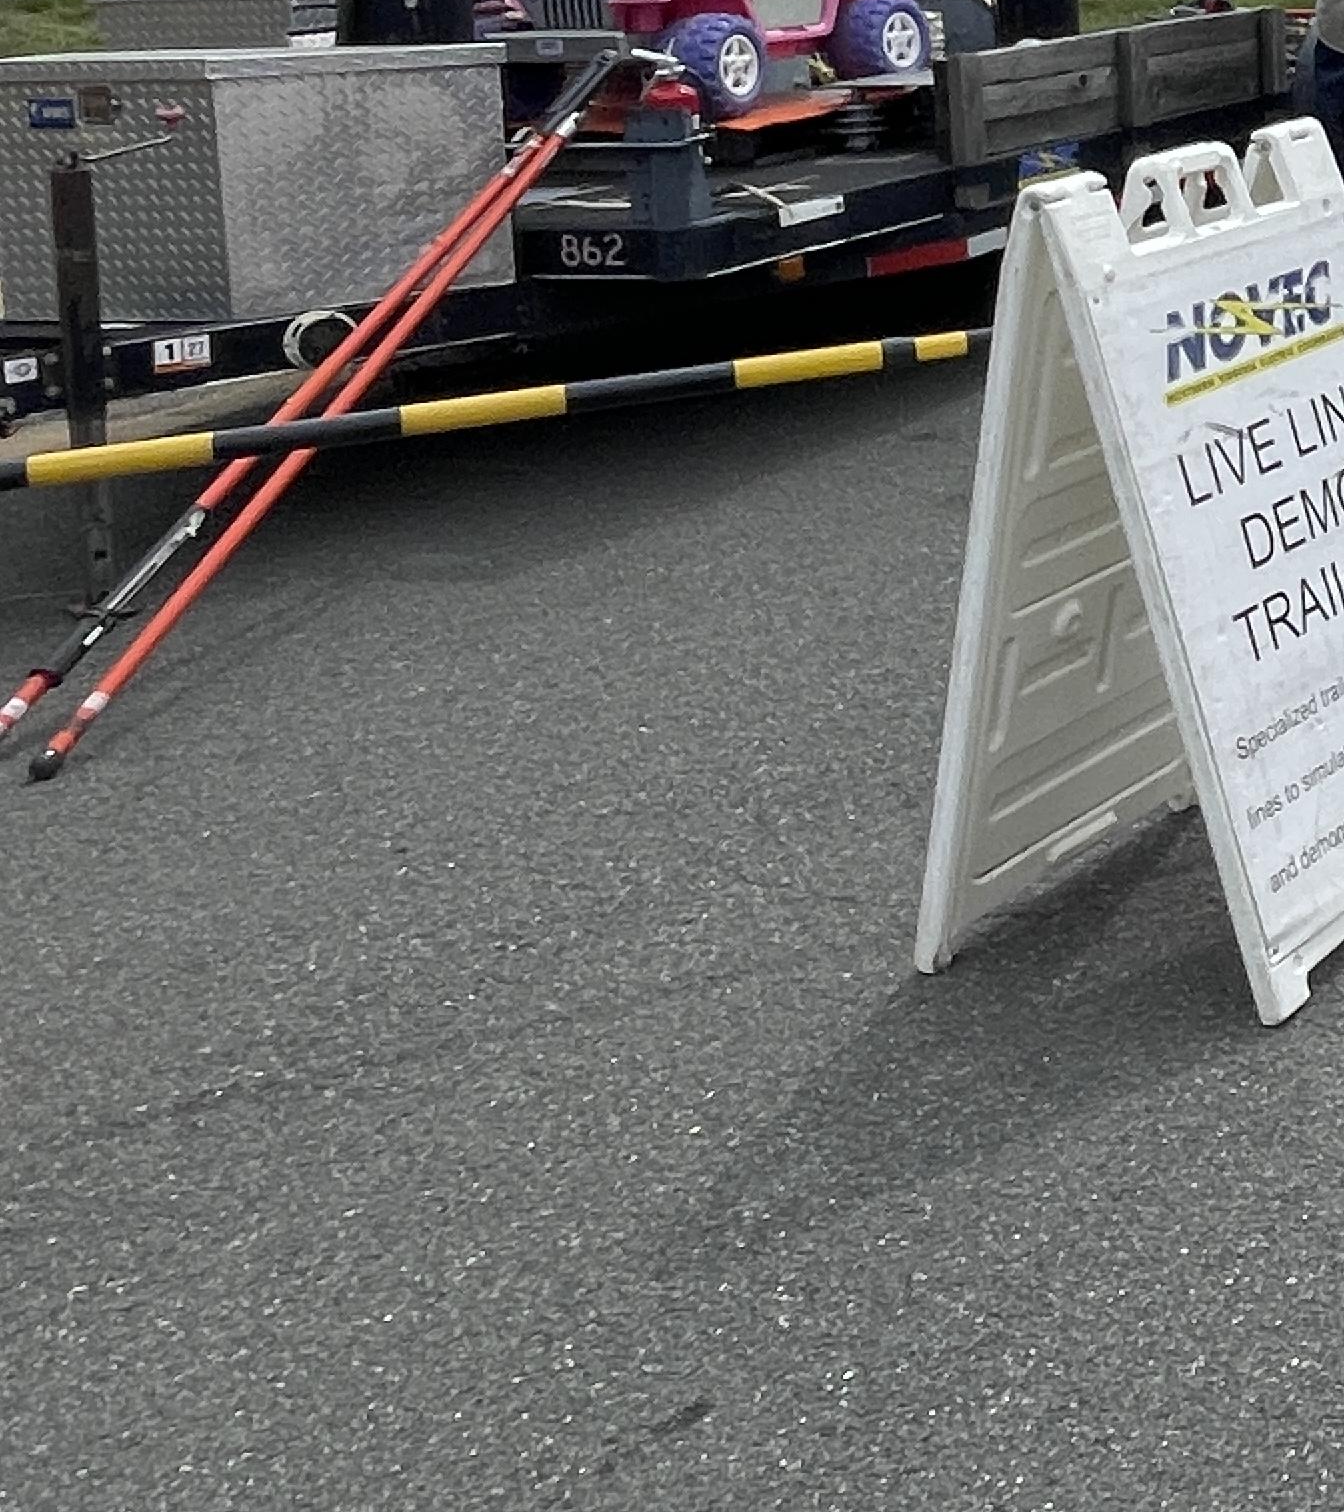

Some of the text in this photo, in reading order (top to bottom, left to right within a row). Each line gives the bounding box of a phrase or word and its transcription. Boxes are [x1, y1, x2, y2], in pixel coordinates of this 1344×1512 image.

[561, 233, 625, 267] 862
[1166, 260, 1331, 384] NOVEC
[1177, 418, 1283, 506] LIVE
[1236, 693, 1318, 760] Specialized
[1247, 794, 1282, 830] lines
[1284, 782, 1300, 804] to
[1269, 854, 1299, 893] and
